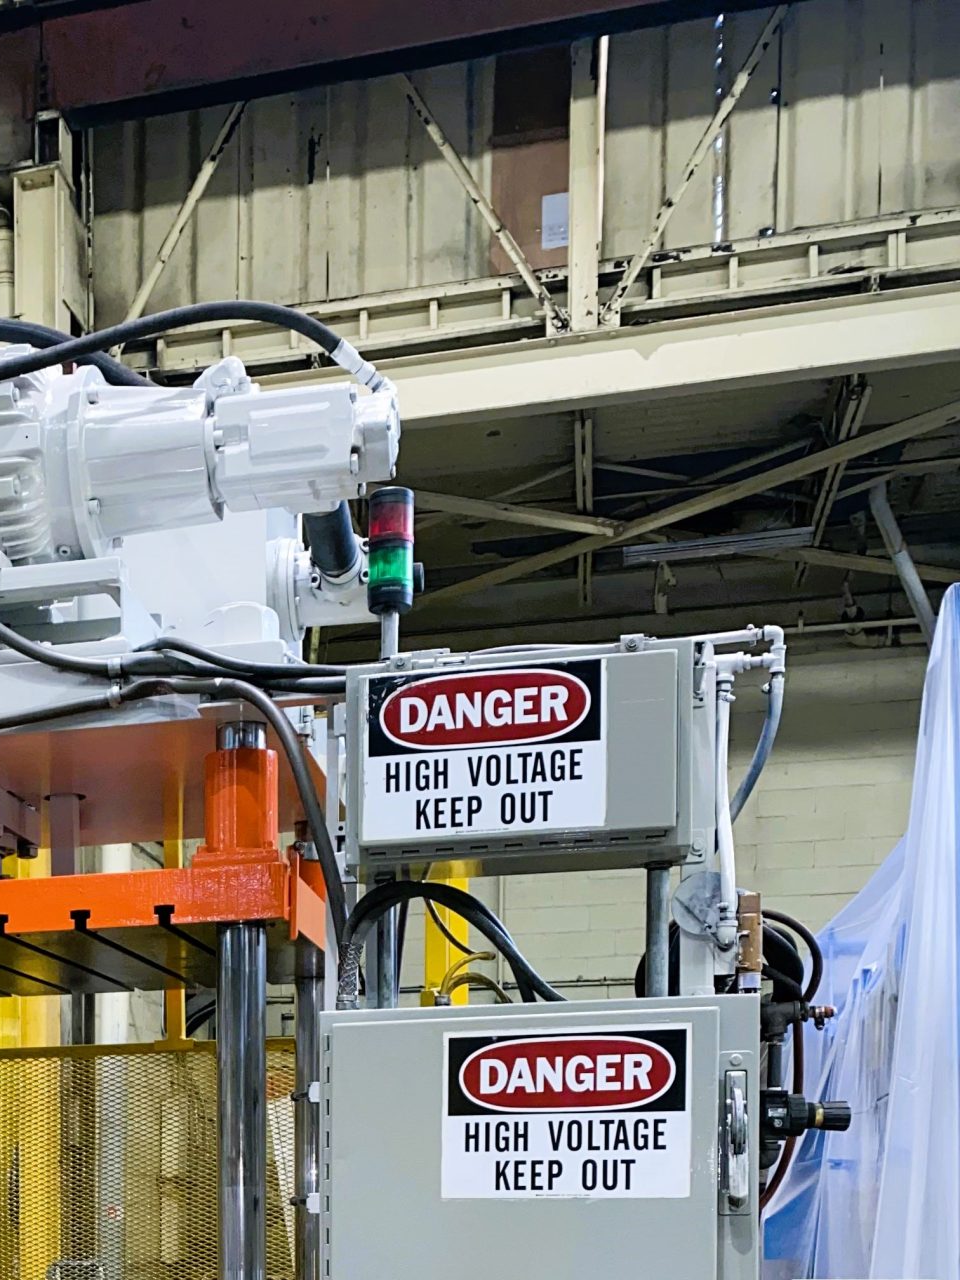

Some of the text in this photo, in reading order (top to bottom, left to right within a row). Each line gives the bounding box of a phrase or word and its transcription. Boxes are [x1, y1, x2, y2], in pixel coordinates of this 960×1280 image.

[399, 684, 570, 734] DANGER
[385, 748, 584, 794] HIGH VOLTAGE
[415, 790, 554, 831] KEEP OUT
[478, 1053, 654, 1095] DANGER
[464, 1118, 668, 1153] HIGH VOLTAGE
[494, 1158, 637, 1191] KEEP OUT
